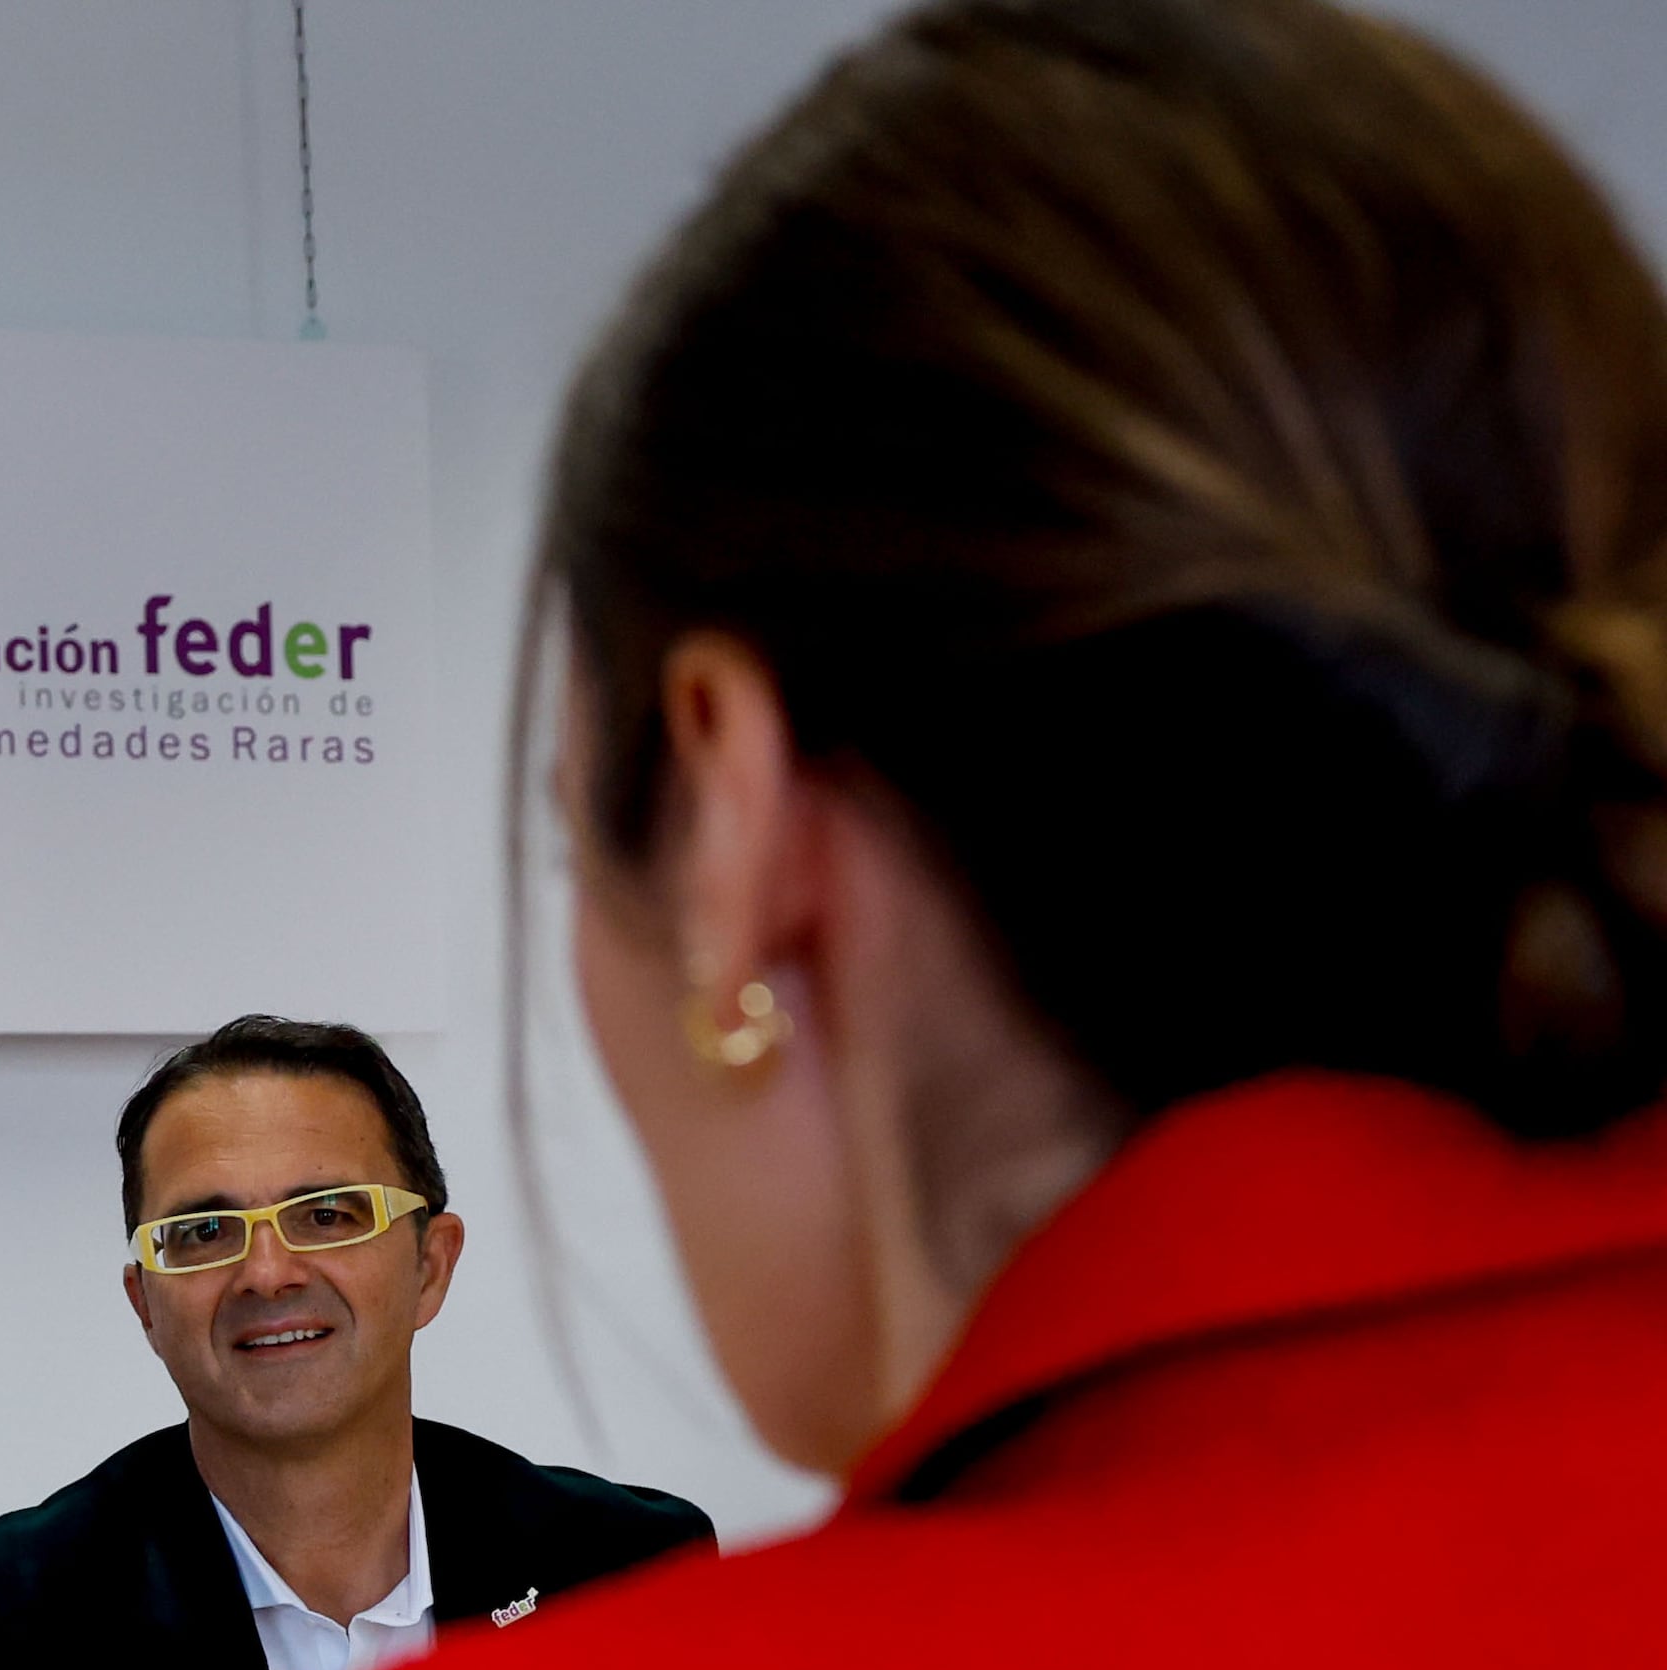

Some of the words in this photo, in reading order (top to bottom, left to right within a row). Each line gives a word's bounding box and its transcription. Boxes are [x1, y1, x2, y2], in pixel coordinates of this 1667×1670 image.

[137, 595, 372, 681] feder
[19, 681, 301, 721] investigación
[328, 690, 374, 717] de
[232, 725, 375, 764] Raras
[494, 1598, 533, 1625] feder
